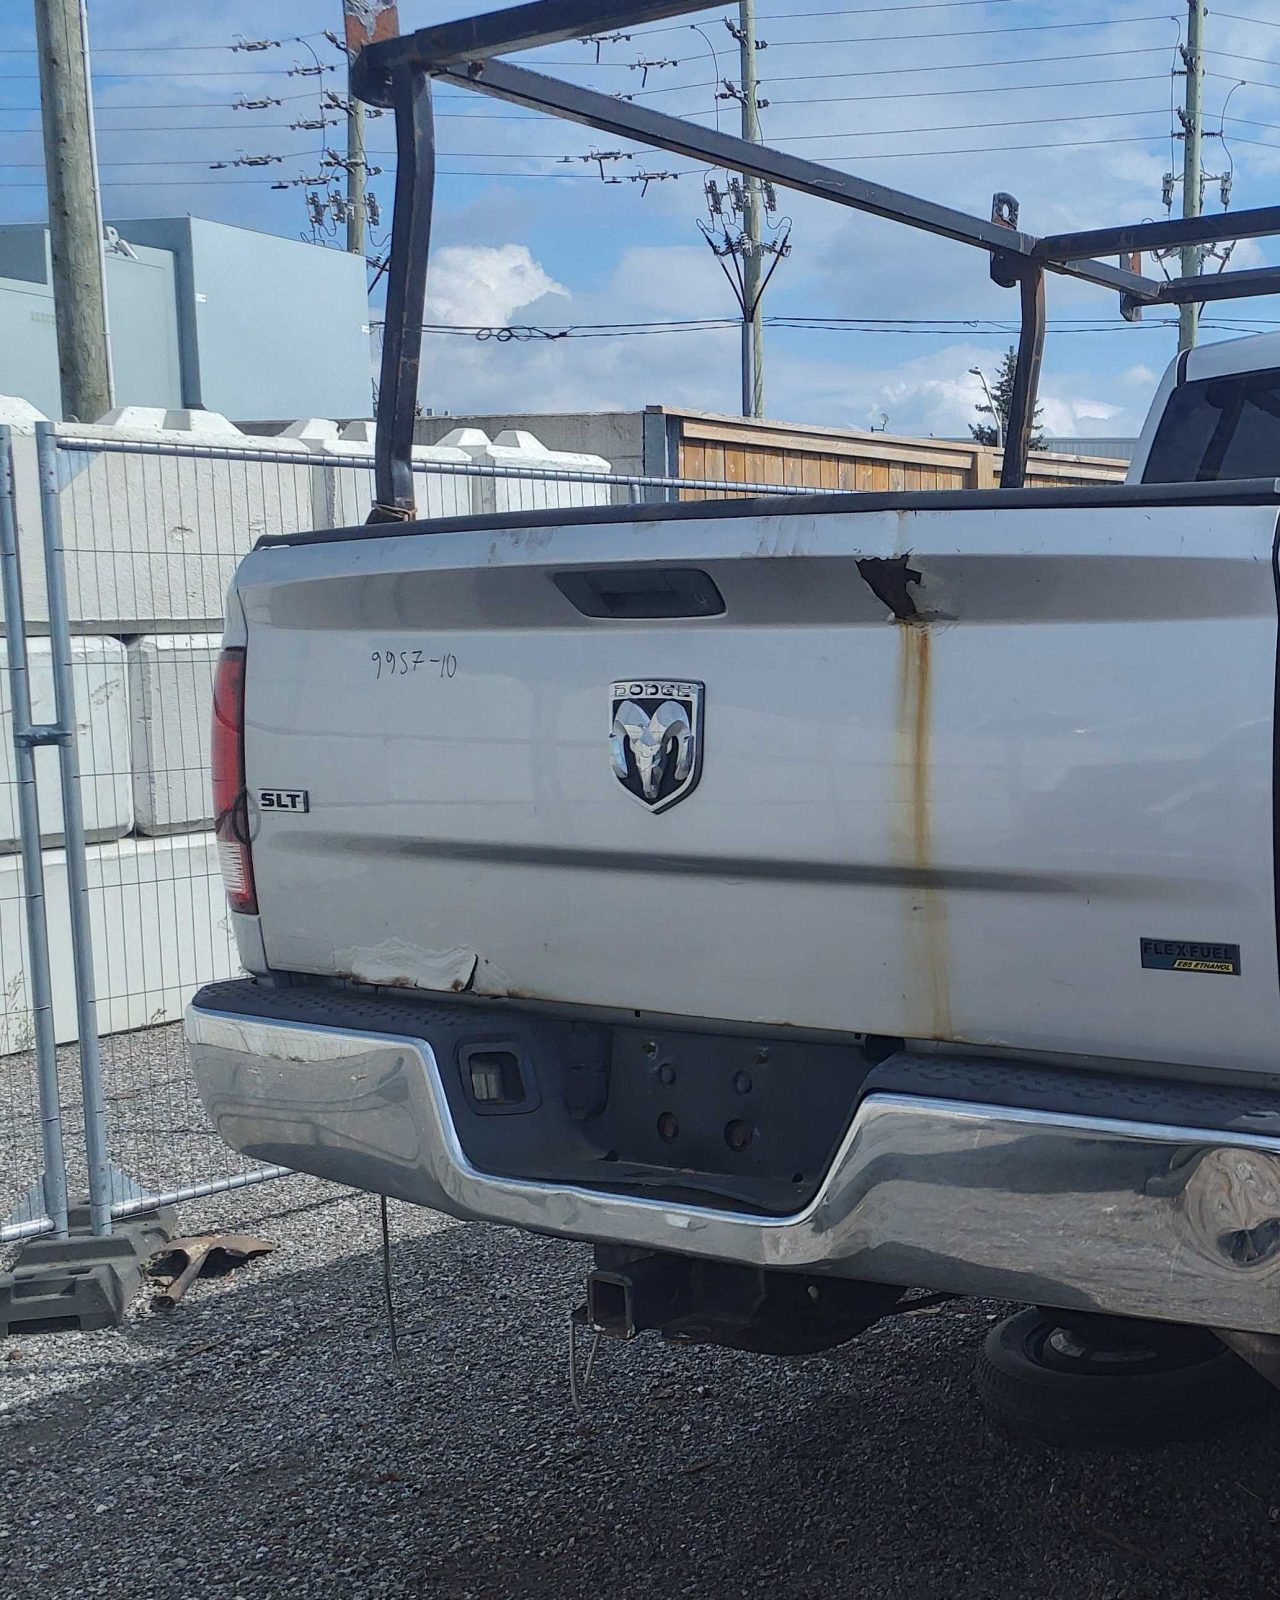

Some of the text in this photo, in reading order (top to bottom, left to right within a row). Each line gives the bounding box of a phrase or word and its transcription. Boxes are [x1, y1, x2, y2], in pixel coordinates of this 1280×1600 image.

[613, 683, 692, 698] DODGE
[261, 792, 301, 809] SLT
[1193, 962, 1232, 971] ETHANOL
